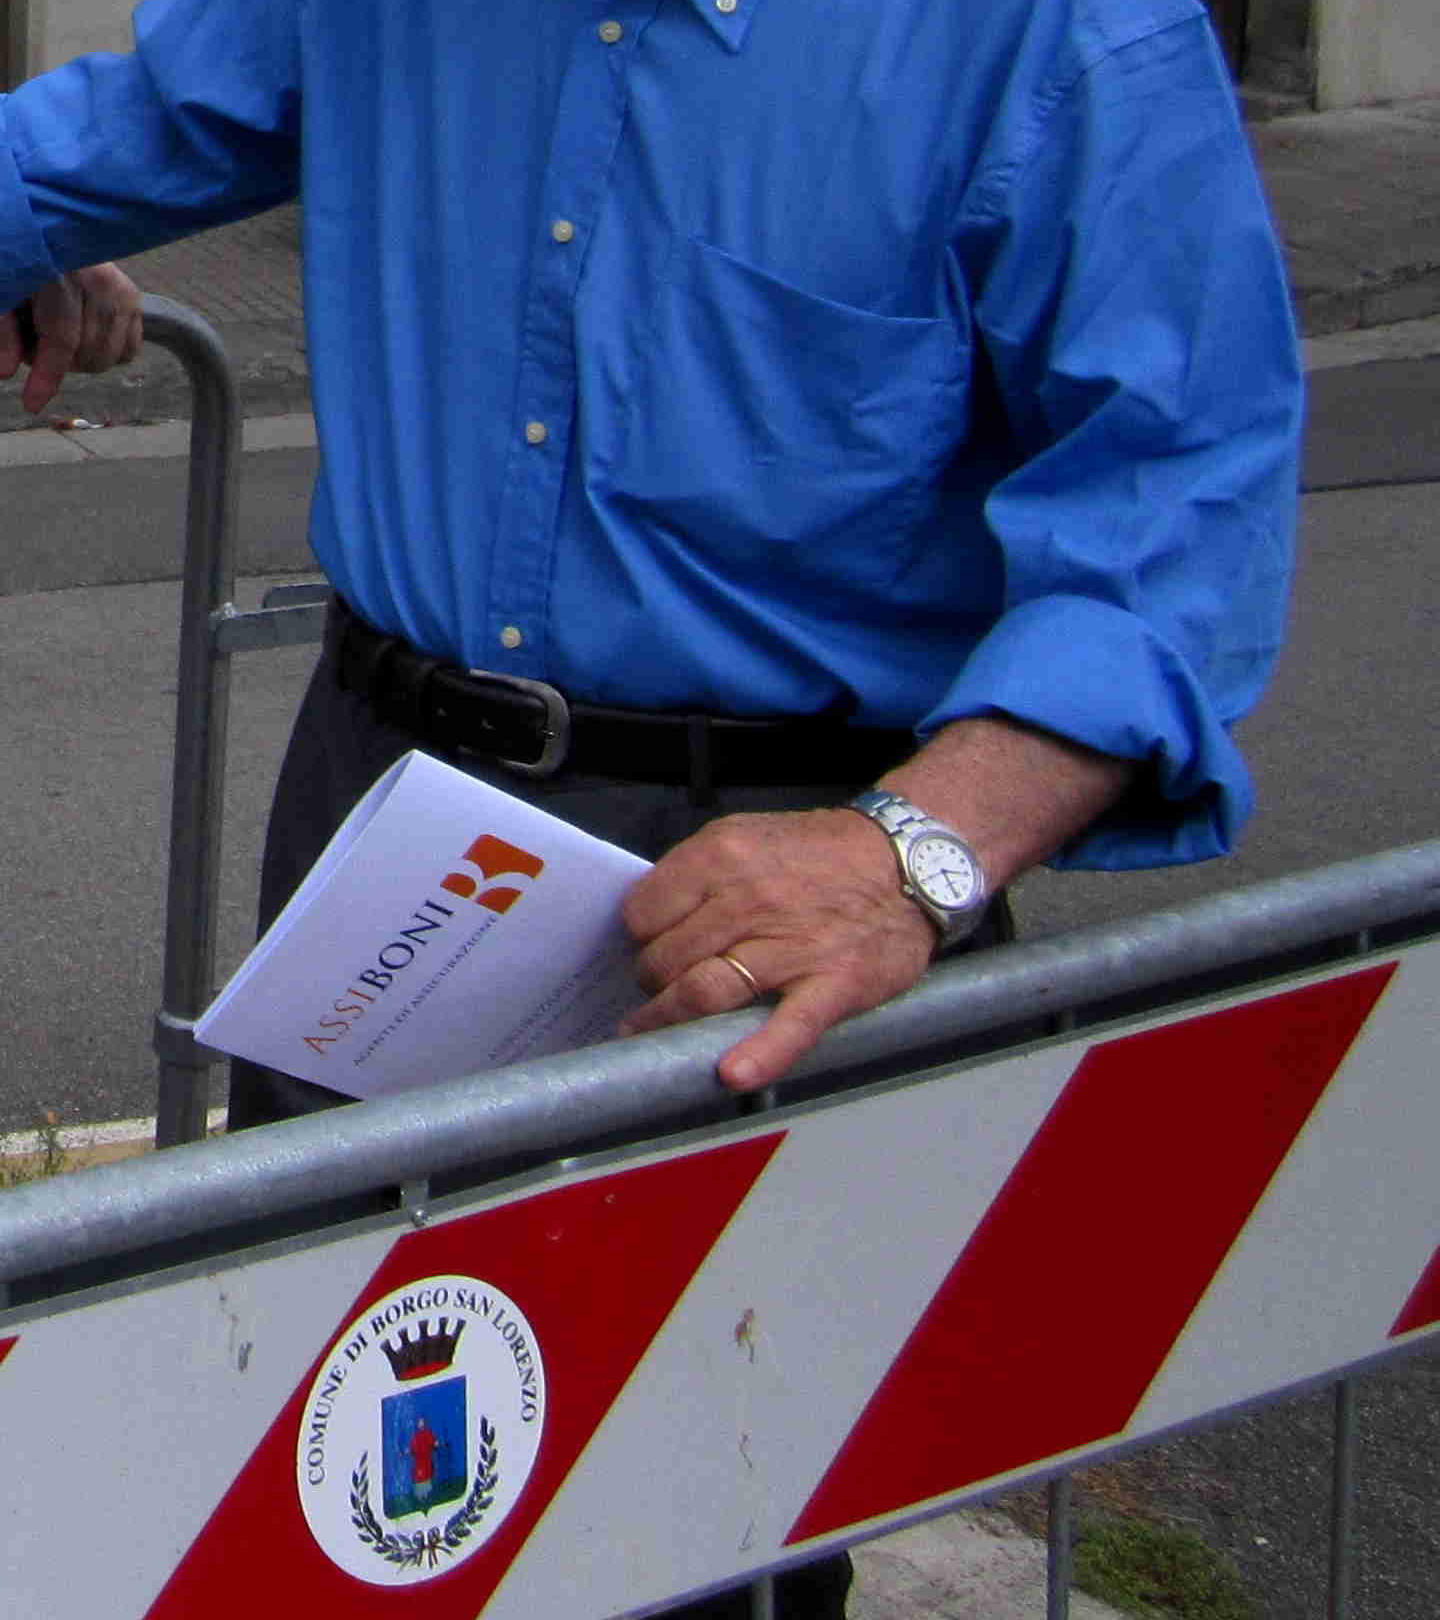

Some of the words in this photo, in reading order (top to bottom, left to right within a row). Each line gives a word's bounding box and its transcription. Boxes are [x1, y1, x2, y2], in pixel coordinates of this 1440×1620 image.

[303, 899, 455, 1055] ASSIBONI
[308, 1364, 348, 1486] COMUNE
[343, 1332, 370, 1364] DI
[371, 1287, 449, 1335] BORGO
[453, 1287, 495, 1318] SAN
[491, 1309, 538, 1423] LORENZO
